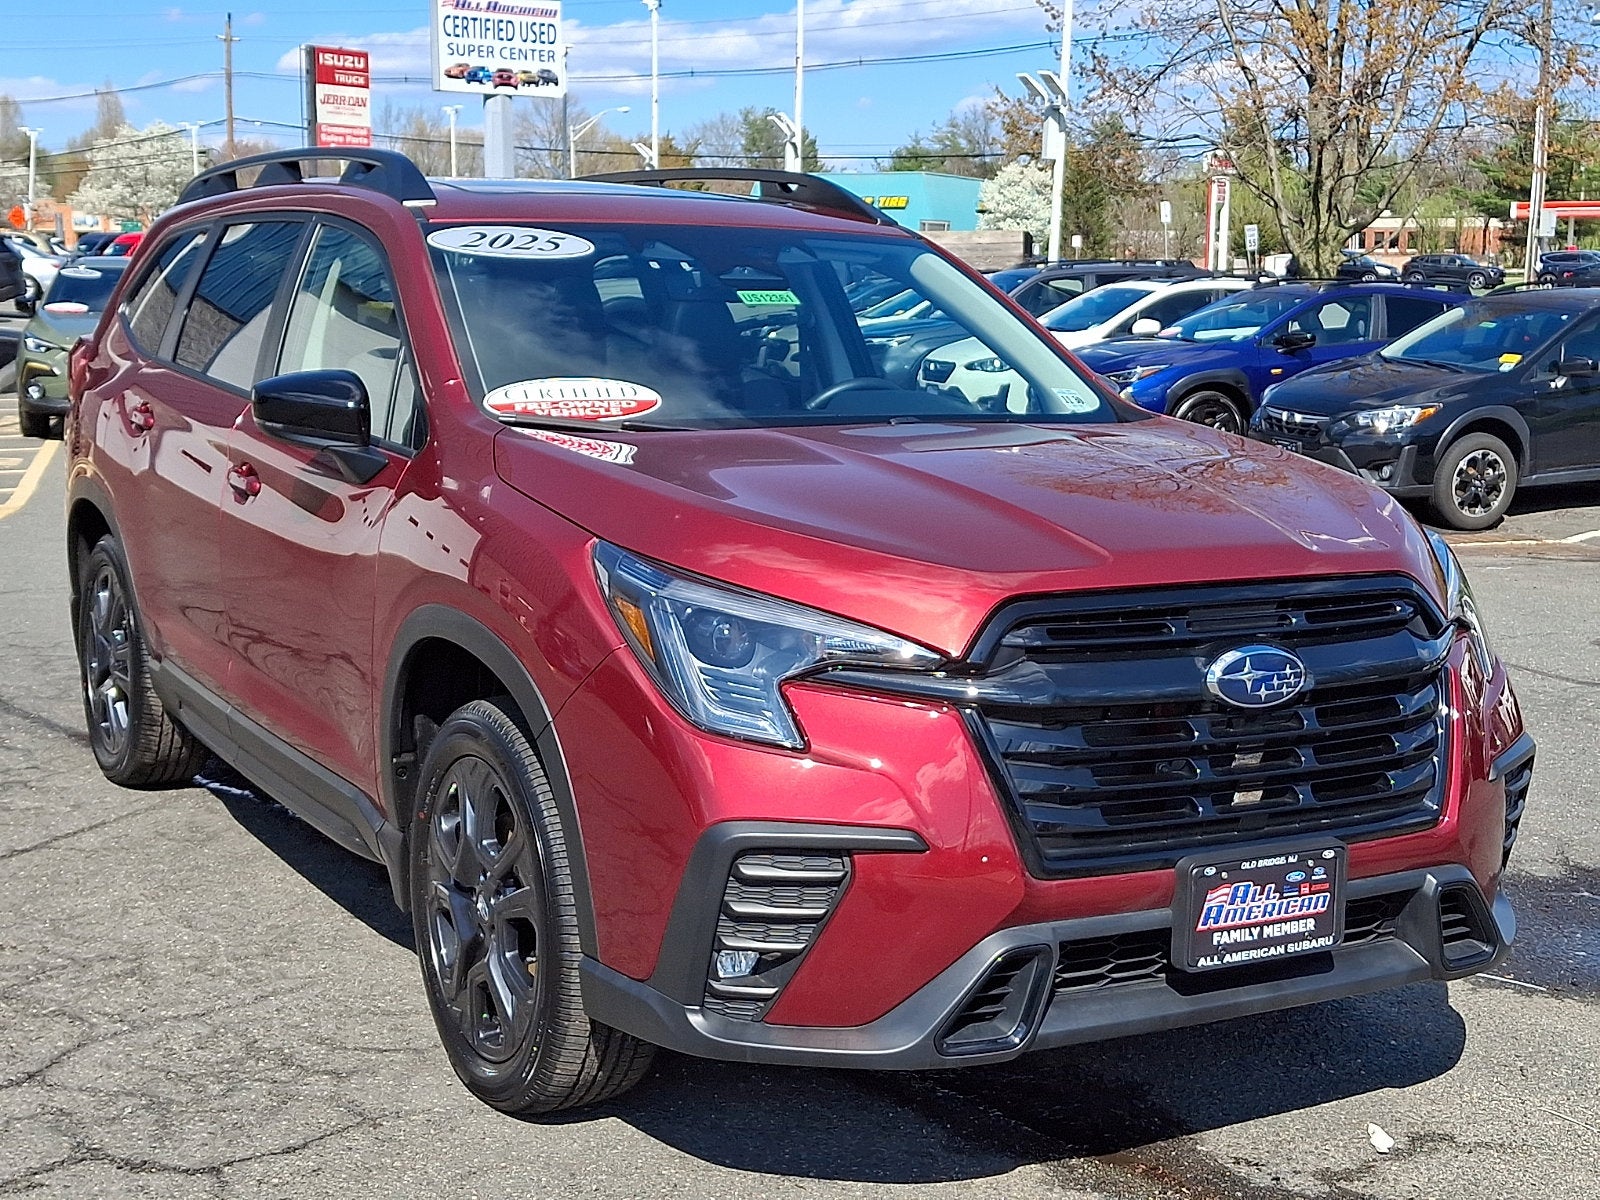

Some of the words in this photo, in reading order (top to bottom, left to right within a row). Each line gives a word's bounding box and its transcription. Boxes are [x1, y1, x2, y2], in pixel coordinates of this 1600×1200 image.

[443, 14, 515, 42] CERTIFIED
[519, 20, 557, 45] USED
[318, 51, 365, 69] ISUZU
[447, 42, 495, 59] SUPER
[499, 46, 556, 62] CENTER
[334, 73, 365, 84] TRUCK
[878, 196, 908, 208] TIRE
[459, 231, 567, 251] 2025
[1248, 238, 1257, 248] 55
[513, 399, 638, 412] PRE-OWNED
[534, 407, 624, 417] VEHICLE
[1240, 858, 1256, 869] OLD
[1287, 854, 1298, 863] NJ
[1212, 926, 1262, 946] FAMILY
[1262, 917, 1316, 938] MEMBER
[1197, 955, 1222, 967] ALL
[1222, 946, 1286, 963] AMERICAN
[1286, 935, 1334, 953] SUBARU
